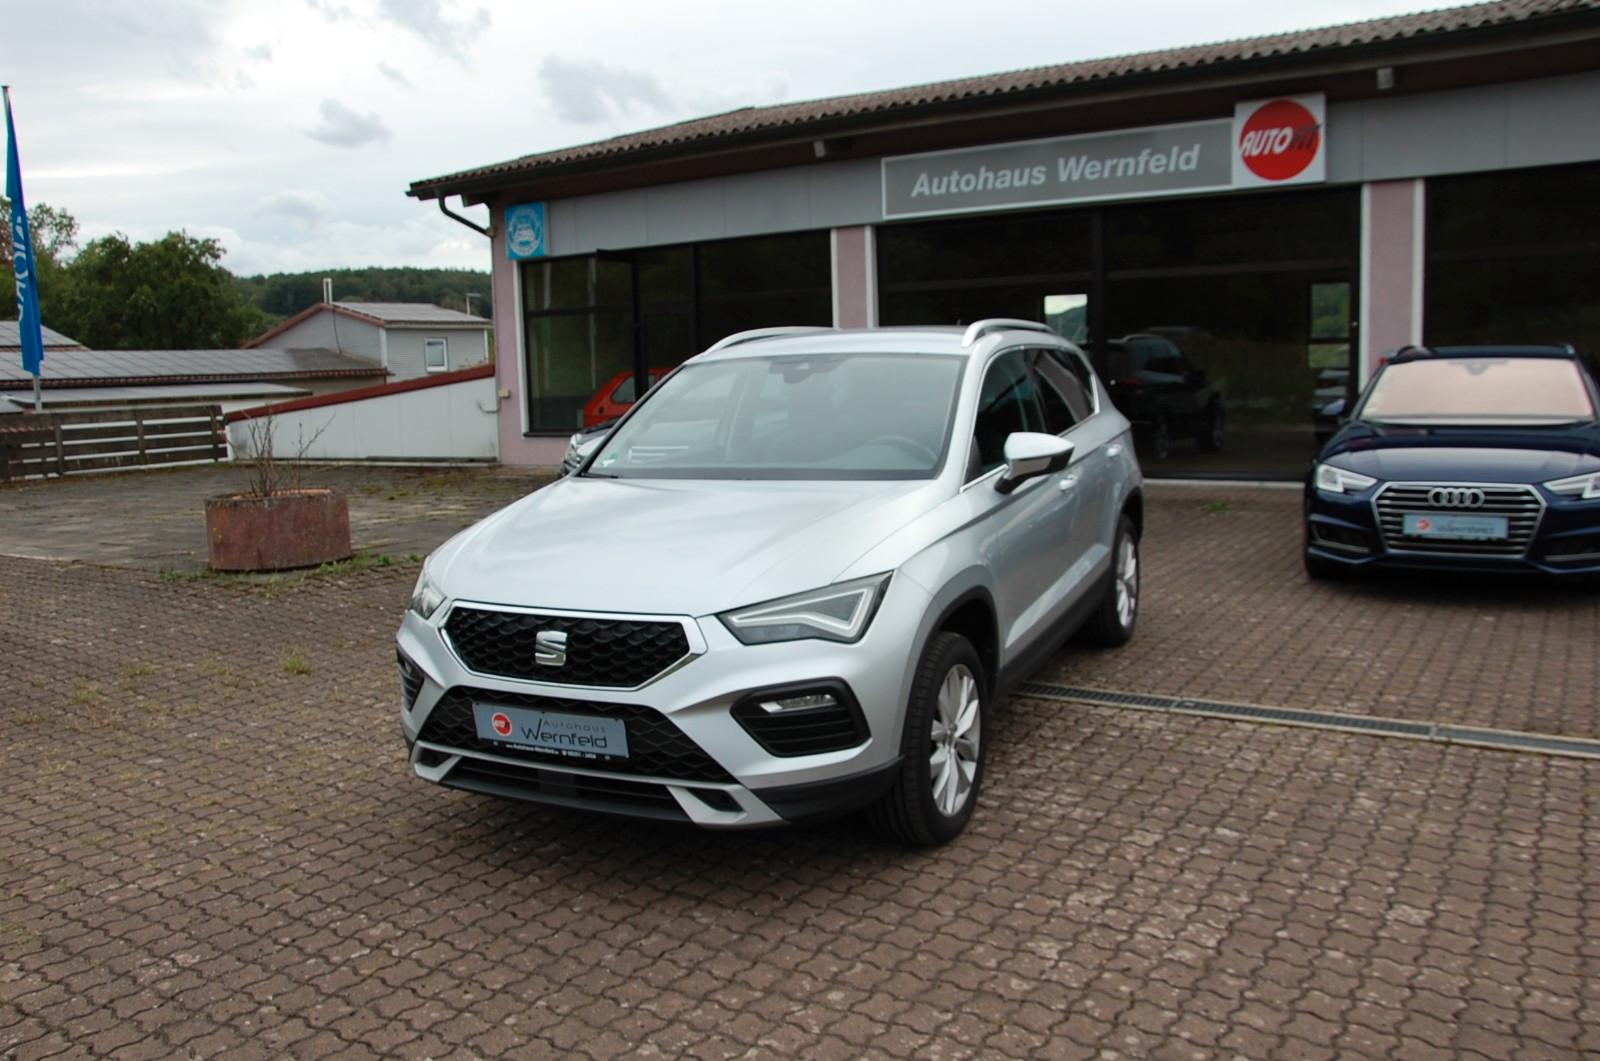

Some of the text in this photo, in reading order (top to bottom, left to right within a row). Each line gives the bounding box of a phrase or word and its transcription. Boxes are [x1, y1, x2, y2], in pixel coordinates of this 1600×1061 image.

[911, 145, 1200, 197] Autohaus Wernfeld
[521, 719, 607, 748] Wernfeld
[544, 720, 605, 733] Autohaus
